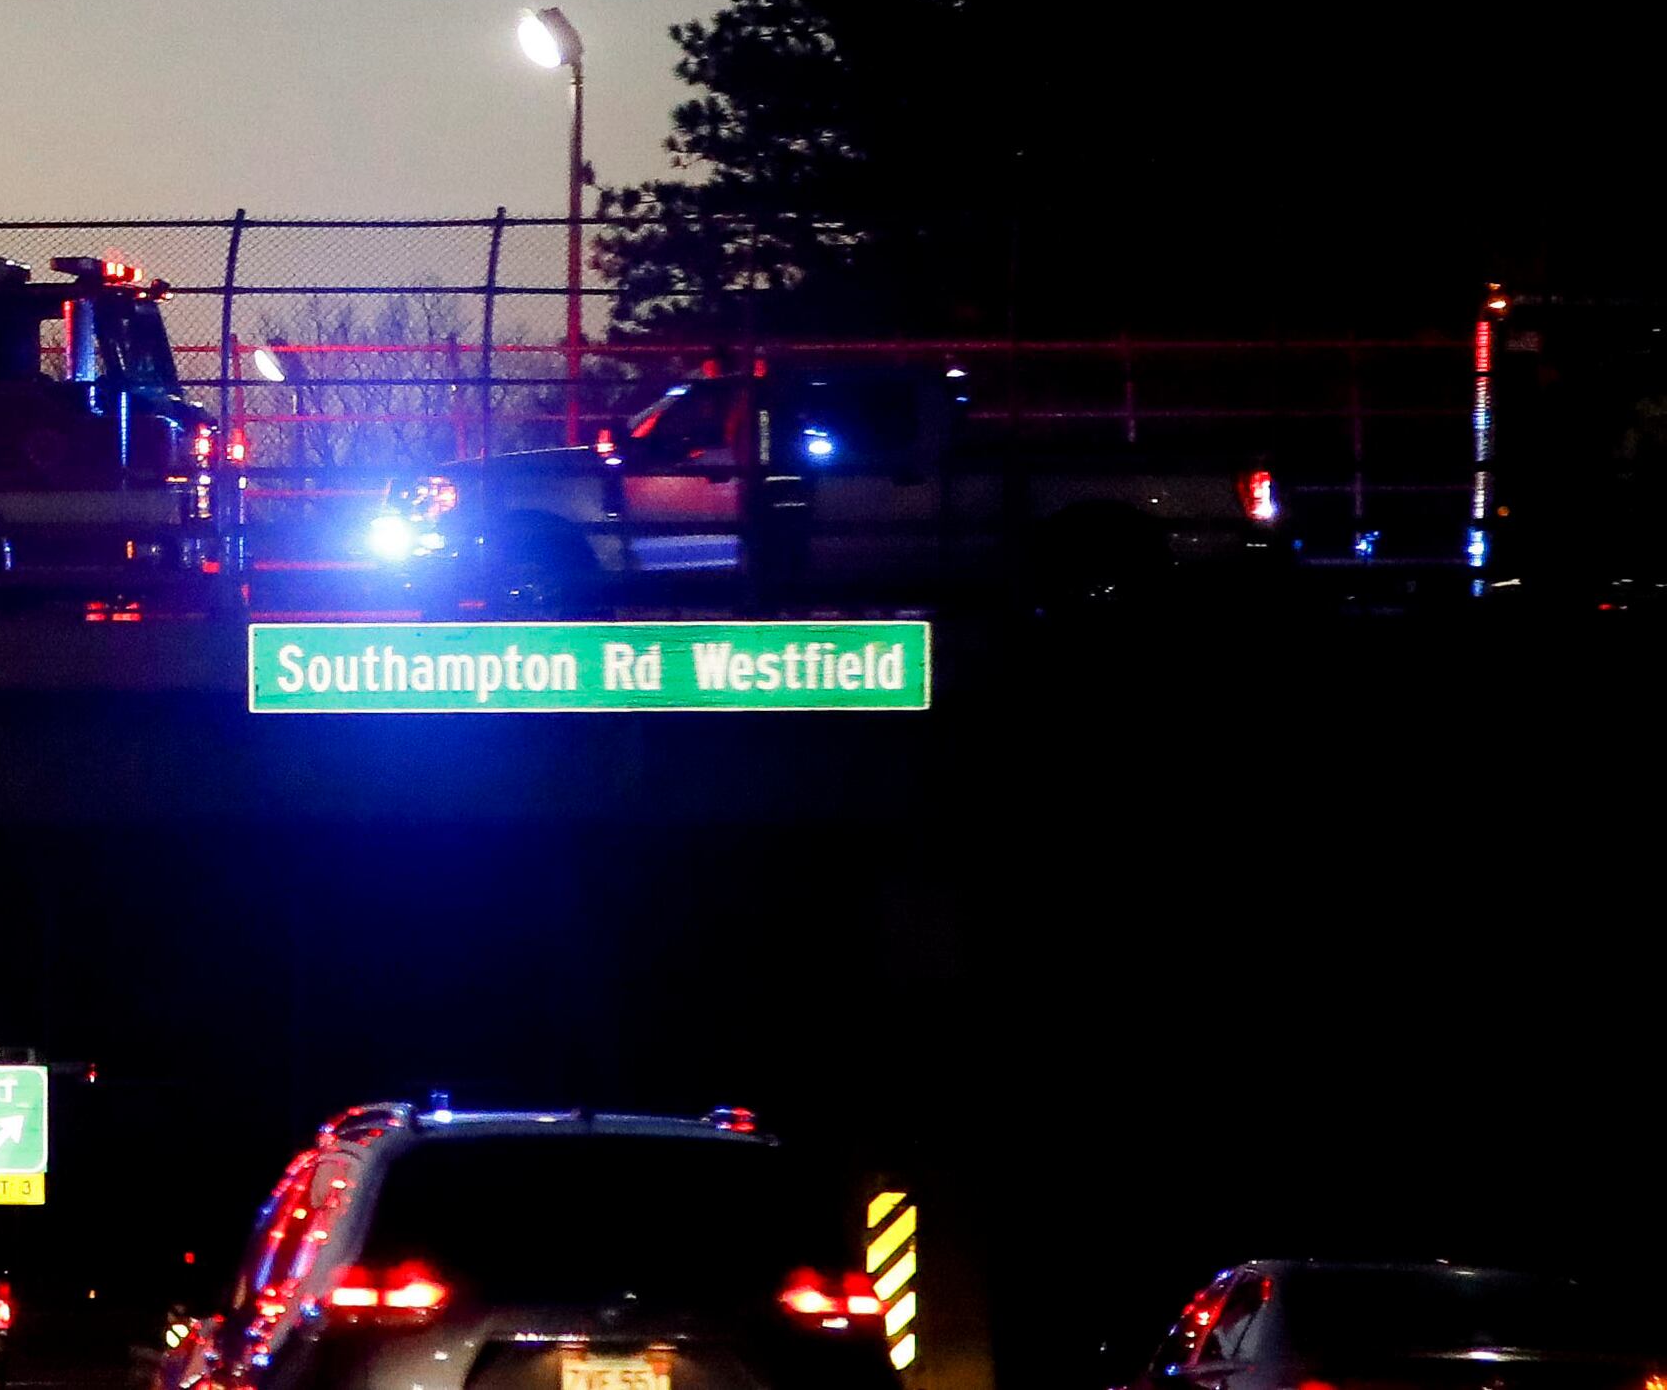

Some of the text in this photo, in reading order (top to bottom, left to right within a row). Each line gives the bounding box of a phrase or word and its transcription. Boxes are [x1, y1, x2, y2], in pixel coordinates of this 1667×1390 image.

[277, 642, 904, 702] Southampton Rd Westfield
[21, 1180, 32, 1196] 3
